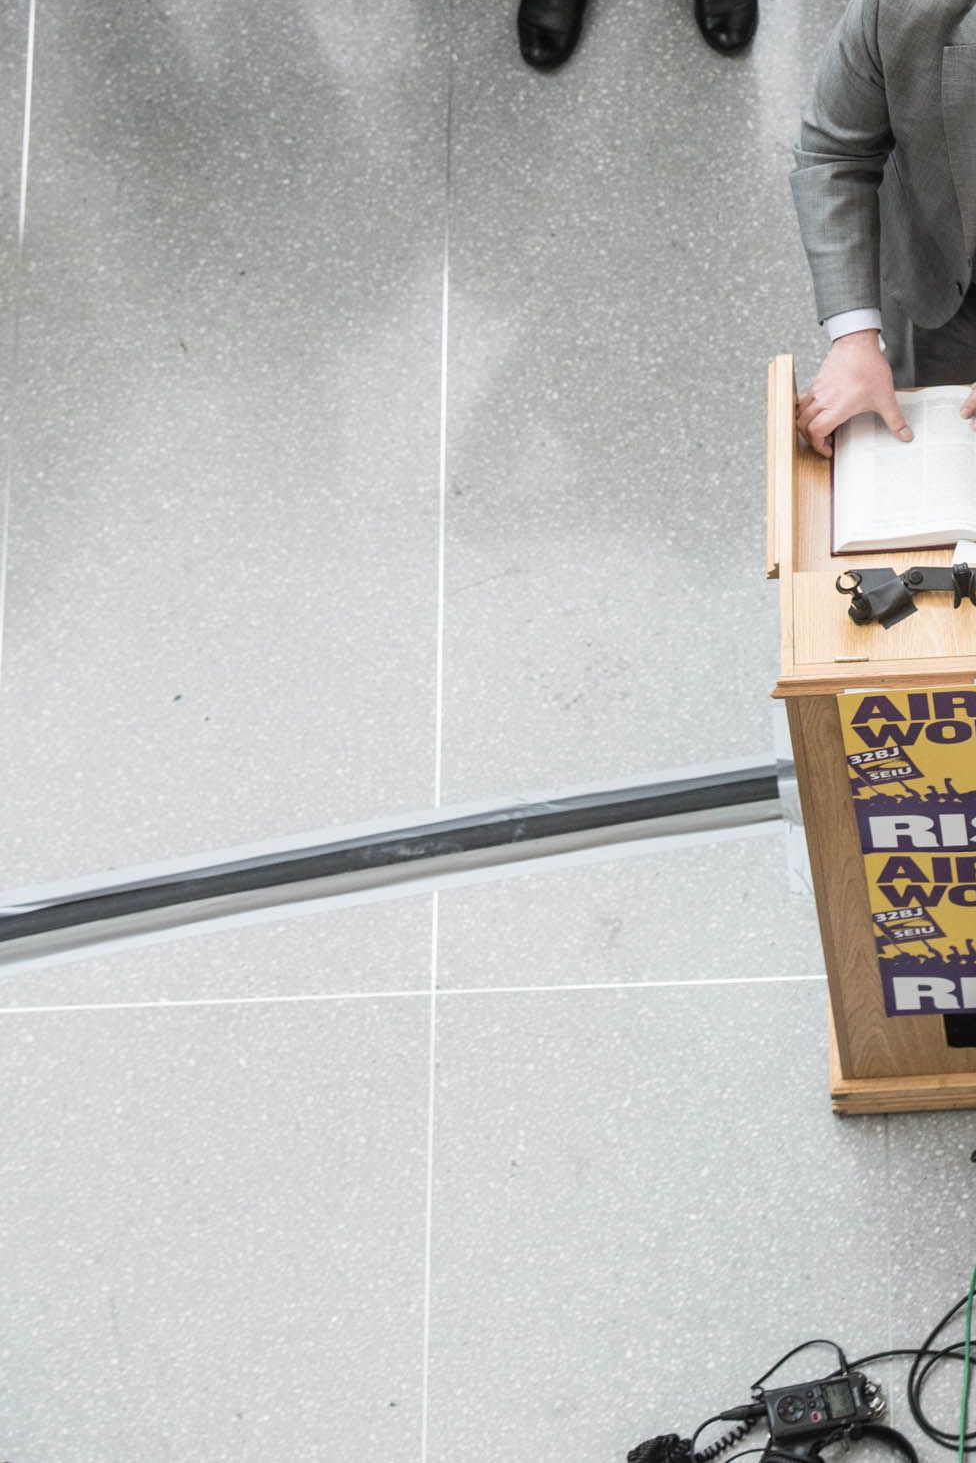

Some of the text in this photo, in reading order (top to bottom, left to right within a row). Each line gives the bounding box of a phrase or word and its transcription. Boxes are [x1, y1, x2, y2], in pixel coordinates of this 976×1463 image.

[849, 746, 900, 765] 32BJ
[869, 766, 913, 781] SEIU
[874, 907, 923, 923] 32BJ
[893, 925, 936, 939] SEIU
